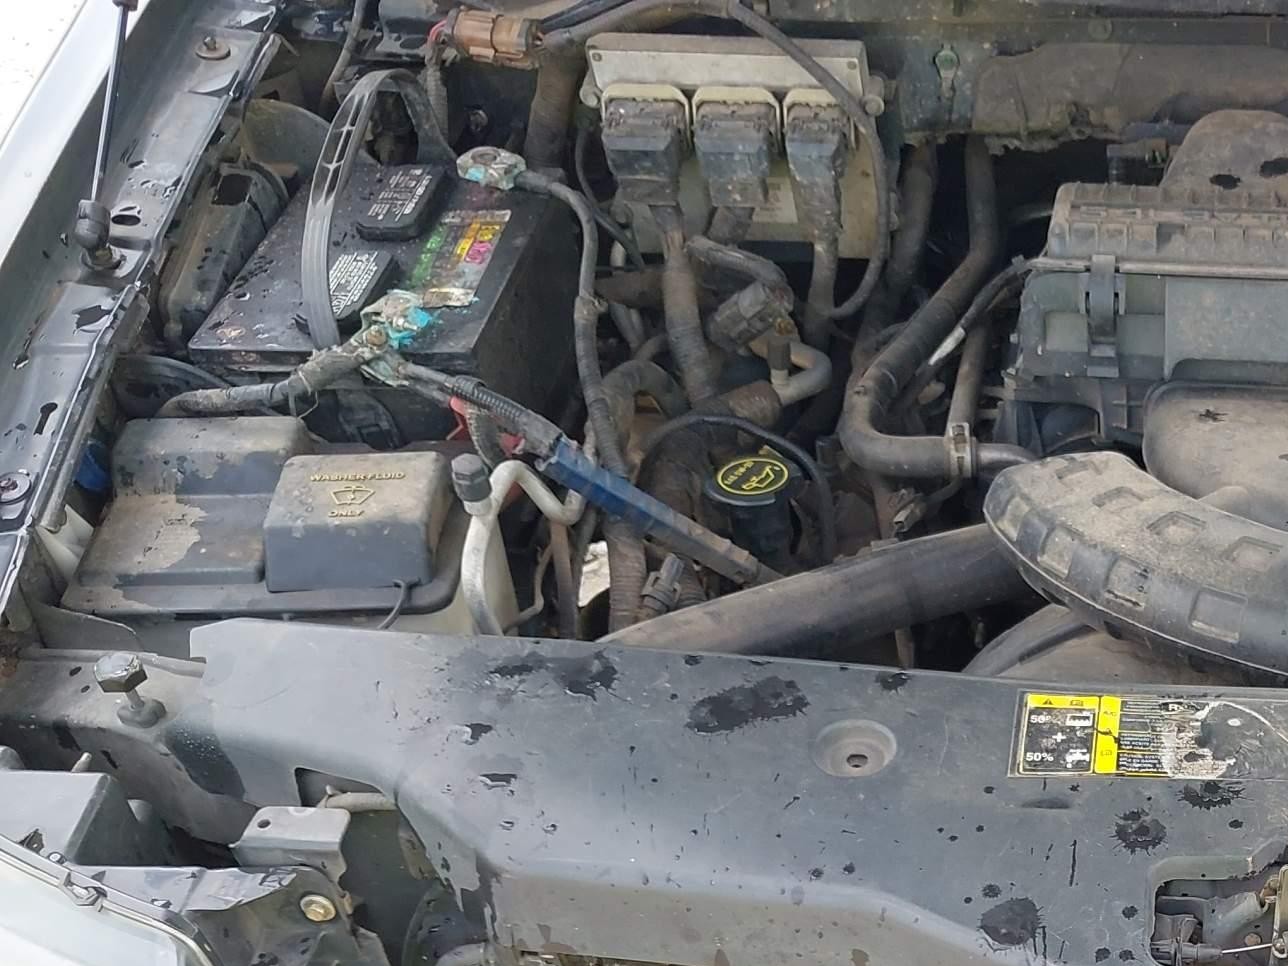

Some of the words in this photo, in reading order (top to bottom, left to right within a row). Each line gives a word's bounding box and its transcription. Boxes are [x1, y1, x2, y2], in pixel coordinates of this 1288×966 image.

[310, 472, 367, 482] WASHER
[367, 471, 406, 481] FLUID
[327, 509, 365, 518] ONLY
[1025, 751, 1055, 762] 50%
